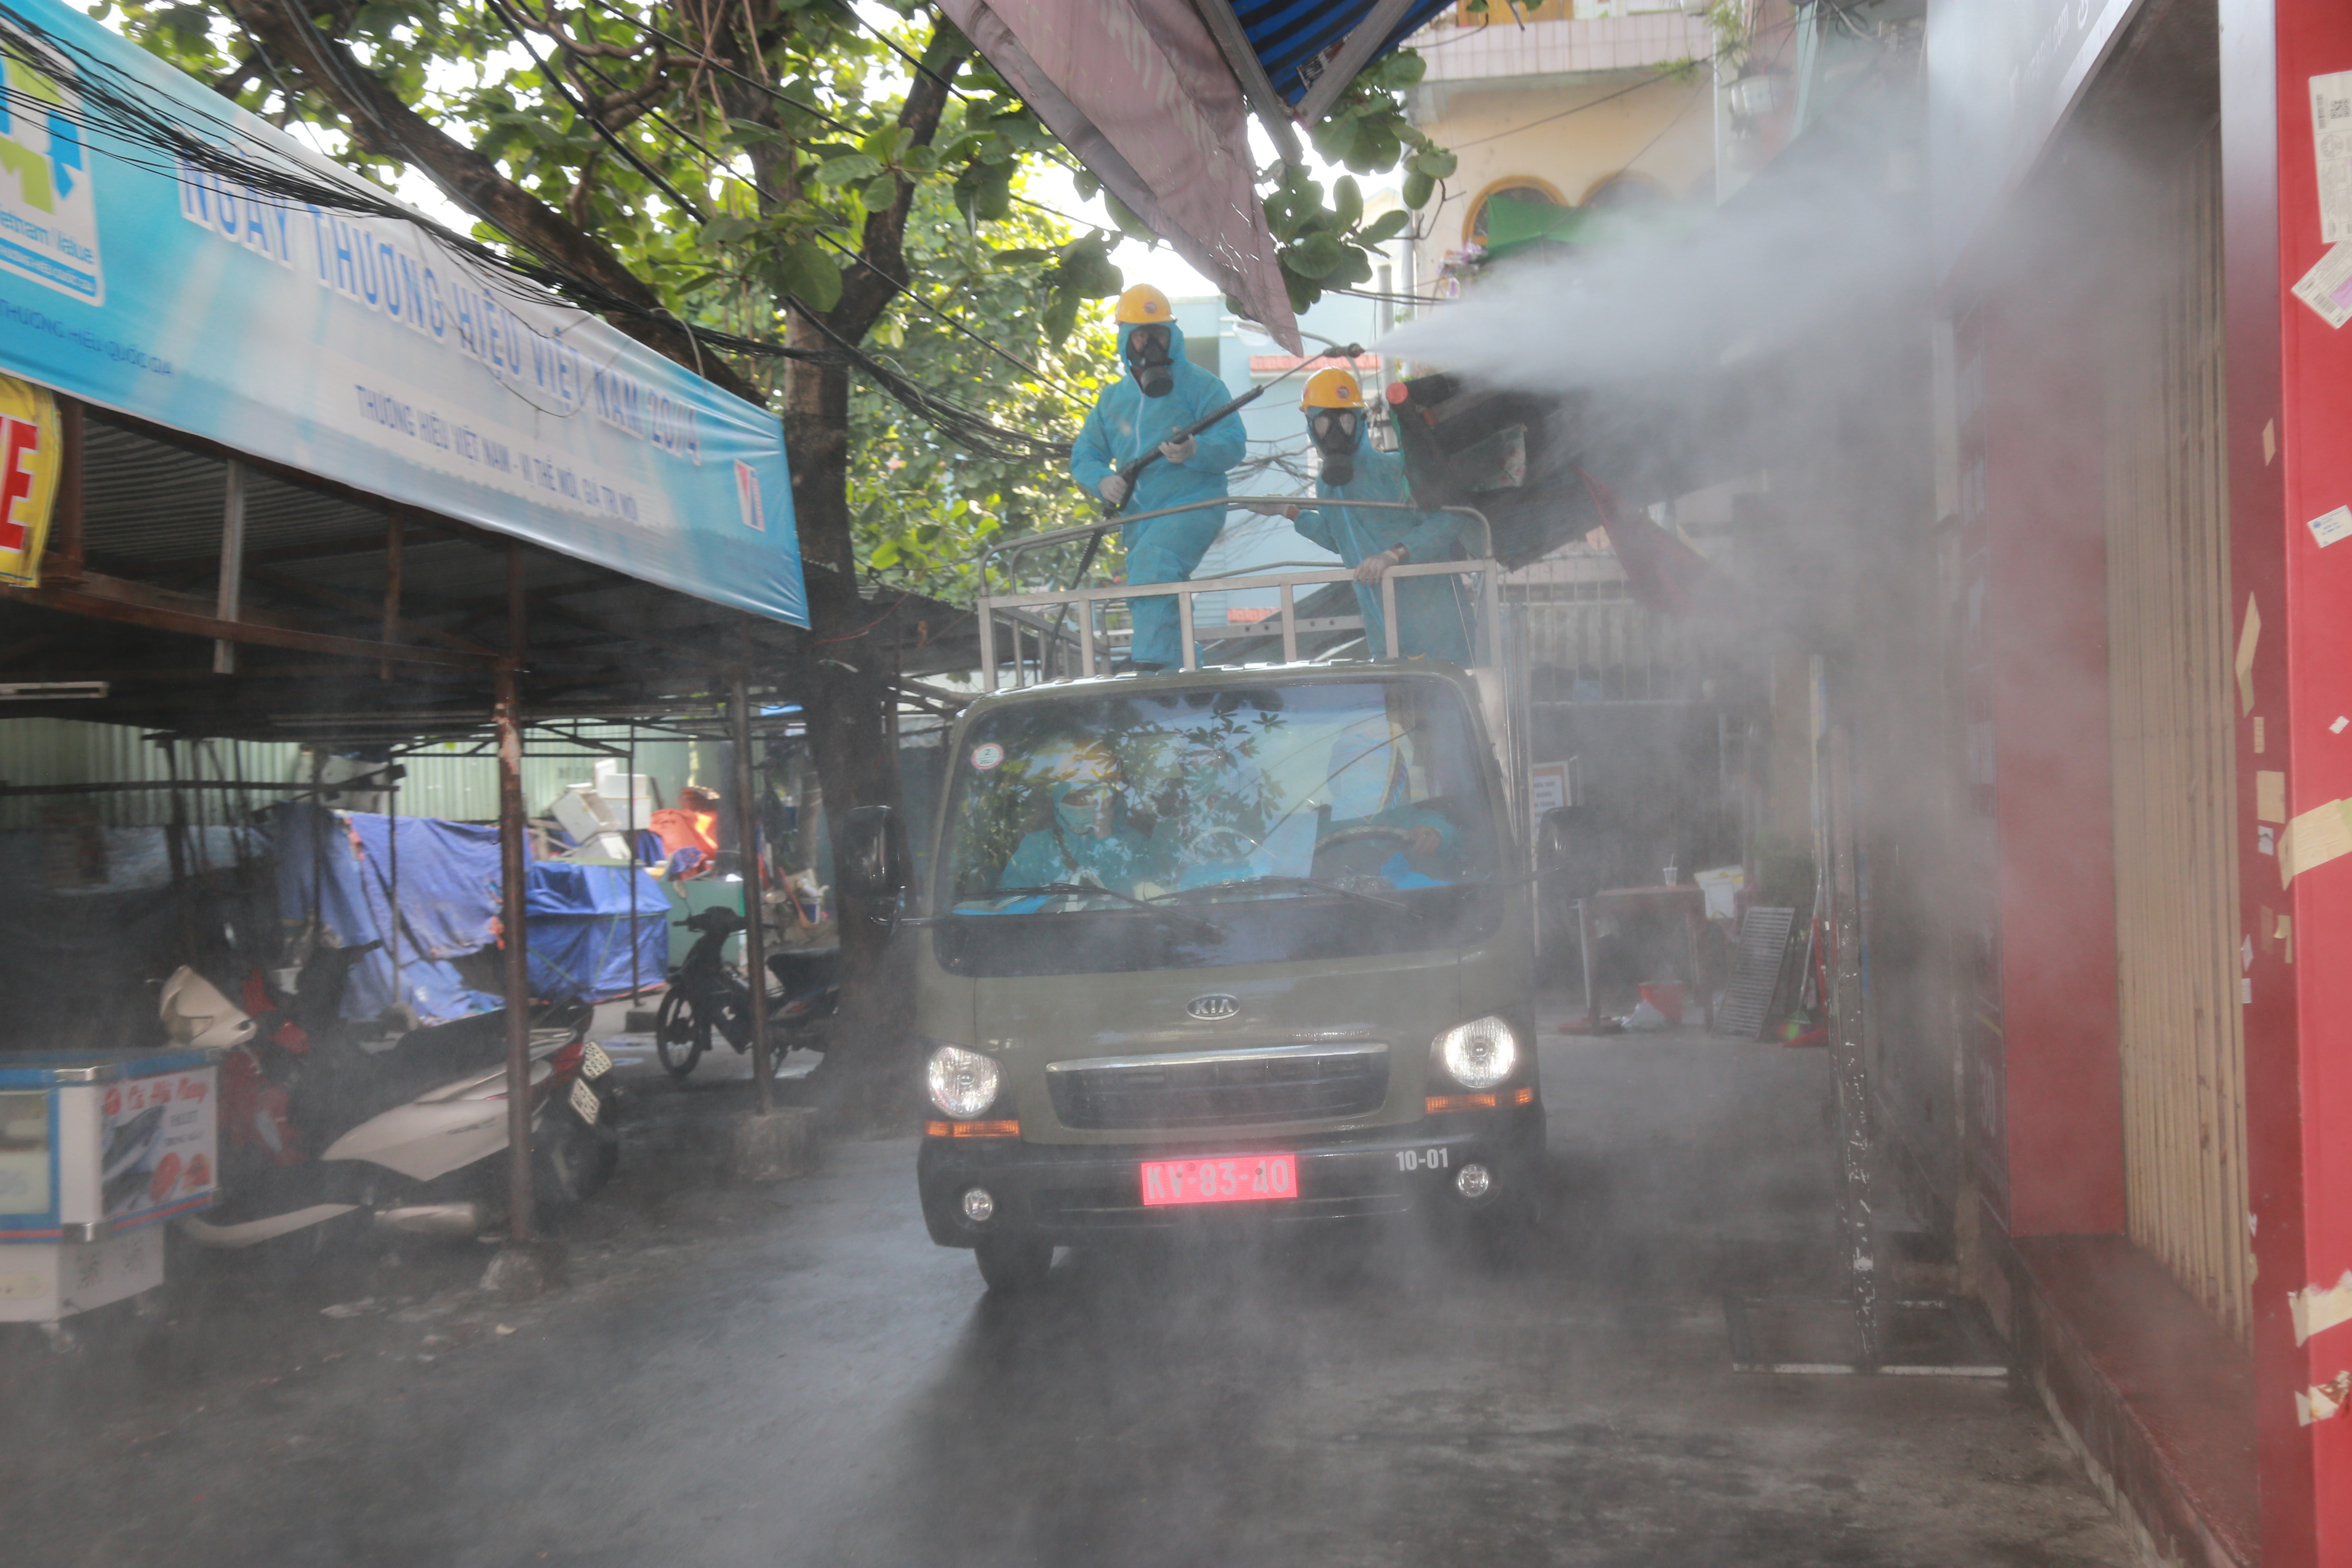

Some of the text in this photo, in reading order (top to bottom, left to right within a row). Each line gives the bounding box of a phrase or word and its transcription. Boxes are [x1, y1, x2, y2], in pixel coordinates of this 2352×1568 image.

[0, 209, 51, 246] etnam
[452, 283, 521, 380] HIỆU
[591, 359, 643, 435] NAM
[481, 437, 511, 474] NAM
[1195, 998, 1233, 1015] KIA
[1396, 1148, 1448, 1171] 10-01
[1148, 1160, 1289, 1199] KV-83-40
